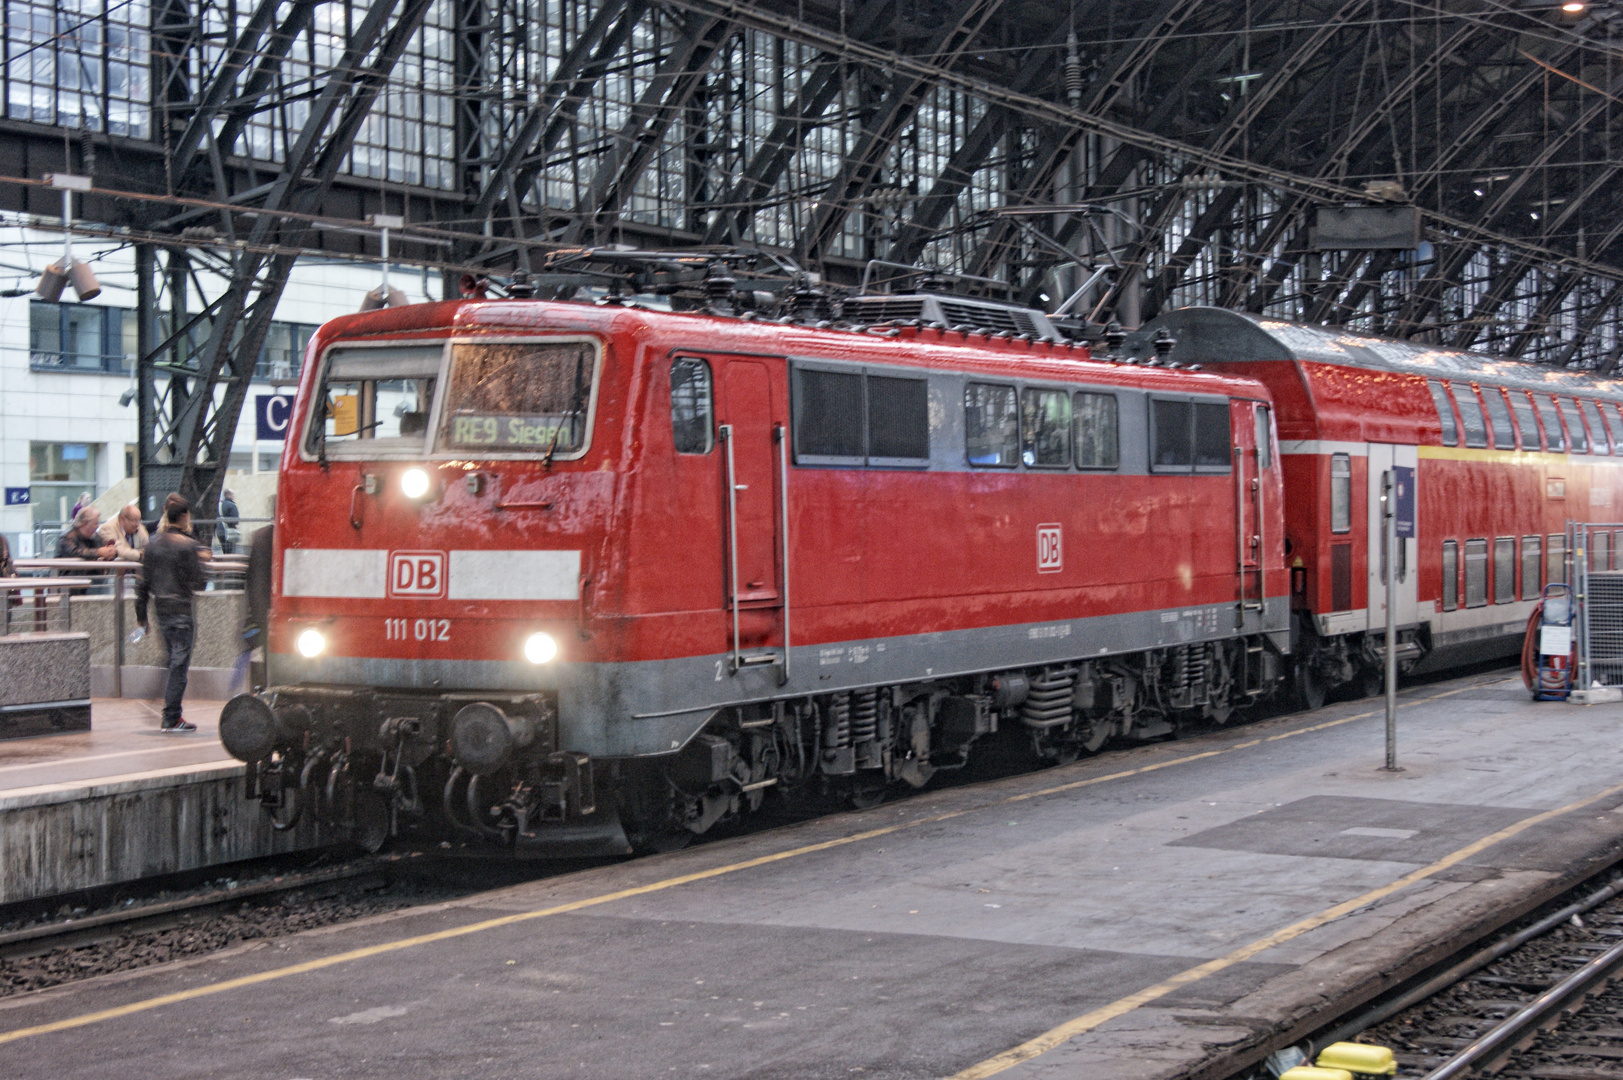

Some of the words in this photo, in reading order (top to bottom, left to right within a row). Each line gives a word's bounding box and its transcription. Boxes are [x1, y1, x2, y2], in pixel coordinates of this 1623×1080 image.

[266, 396, 289, 431] C
[454, 417, 498, 444] RE9
[507, 417, 570, 445] Siegen
[1041, 532, 1059, 564] DB
[397, 559, 436, 590] DB
[384, 618, 407, 640] 111
[414, 618, 450, 641] 012
[715, 660, 723, 681] 2
